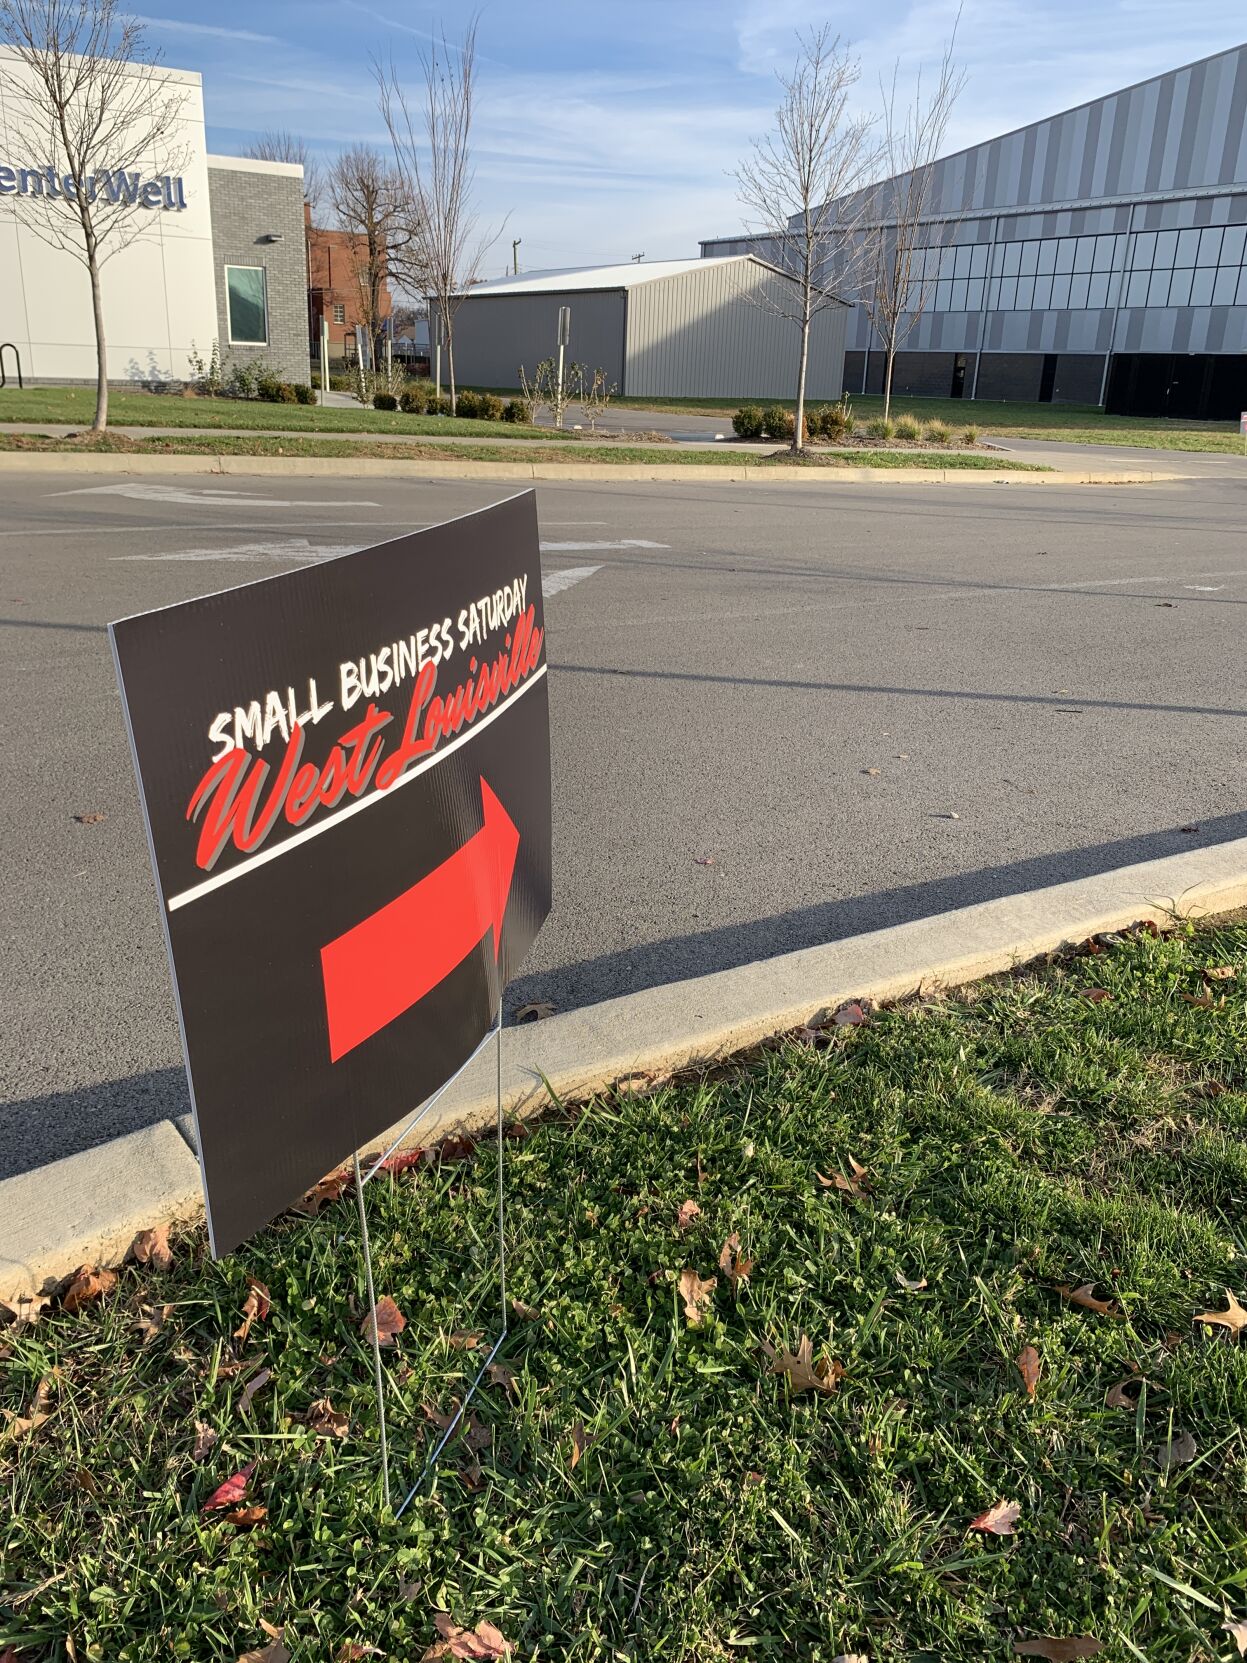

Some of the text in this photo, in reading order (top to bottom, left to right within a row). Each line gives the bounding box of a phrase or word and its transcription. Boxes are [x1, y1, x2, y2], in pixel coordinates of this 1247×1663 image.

[186, 603, 545, 871] West Louisville
[208, 573, 528, 763] SMALL BUSINESS SATURDAY
